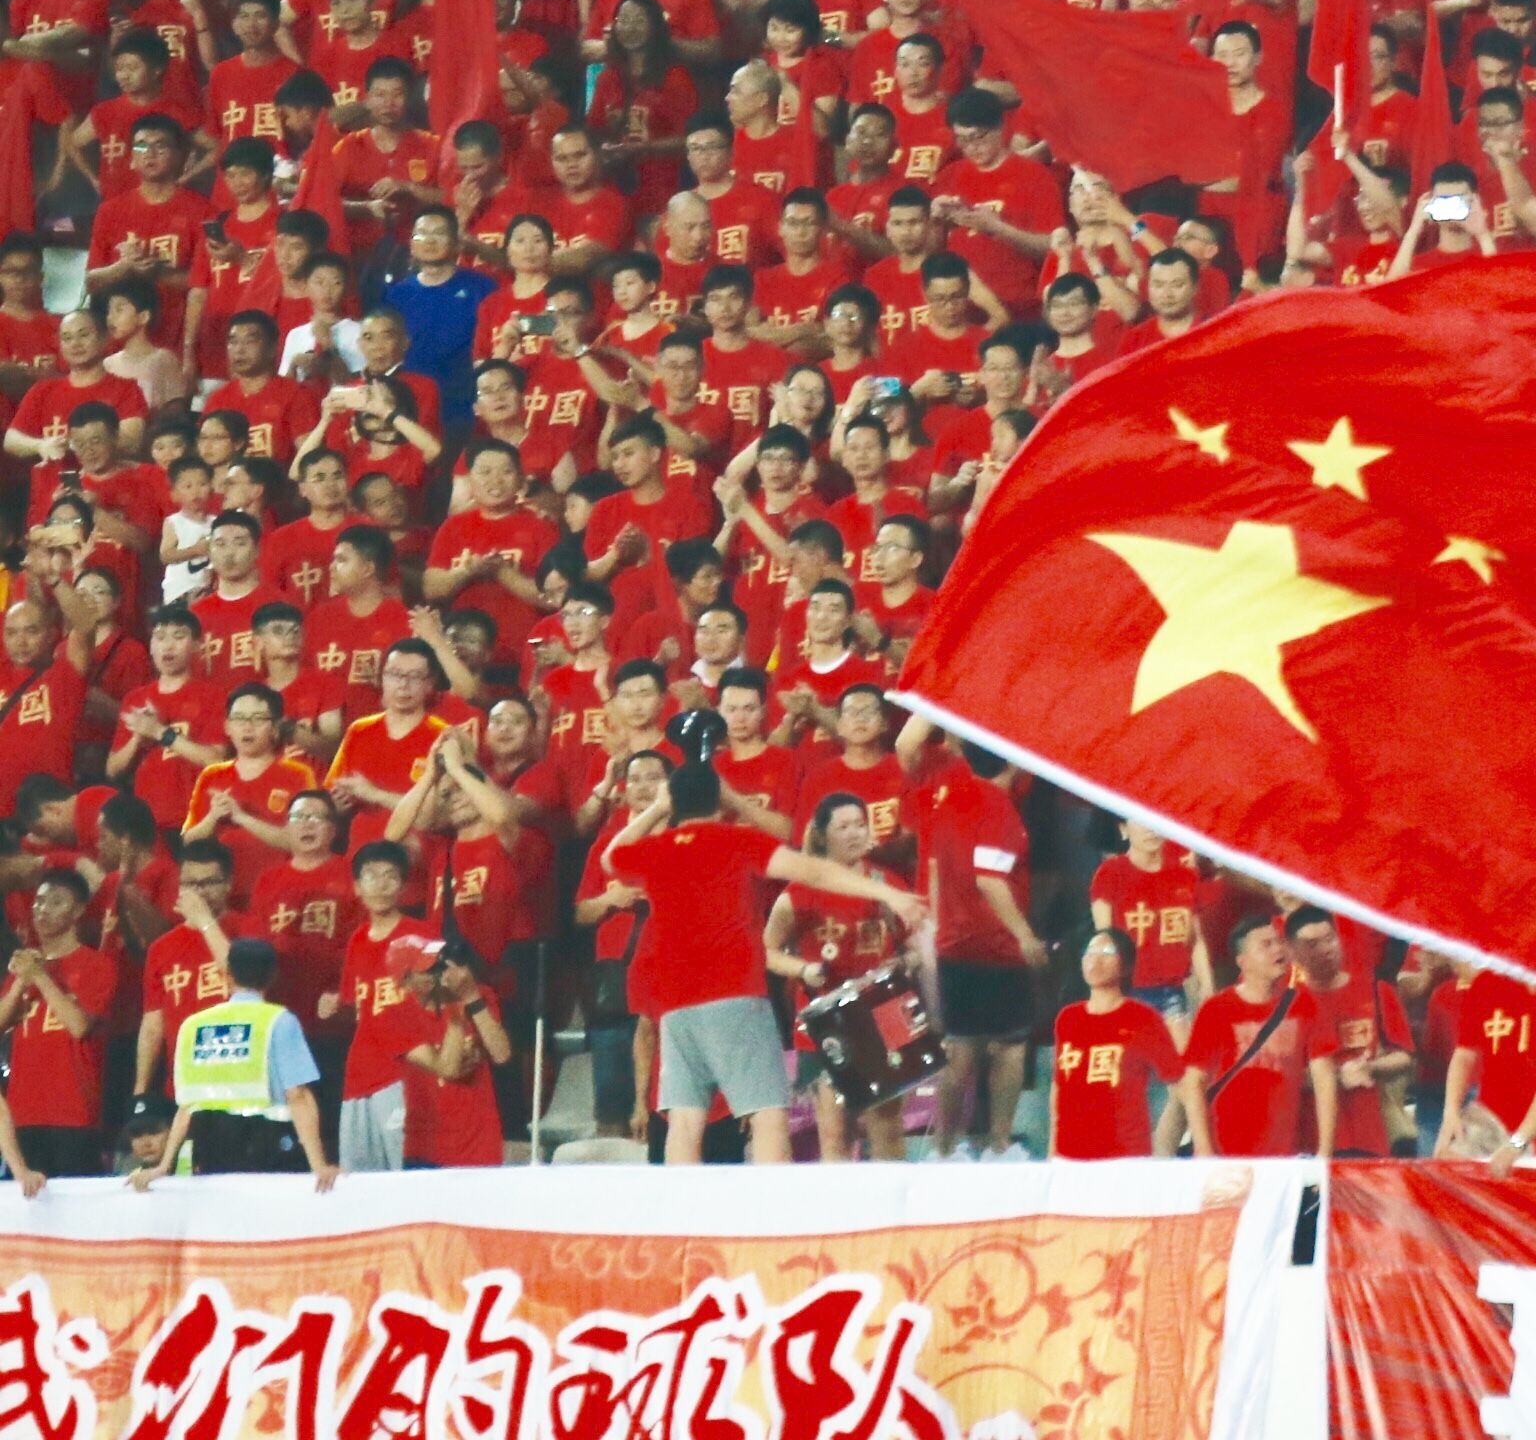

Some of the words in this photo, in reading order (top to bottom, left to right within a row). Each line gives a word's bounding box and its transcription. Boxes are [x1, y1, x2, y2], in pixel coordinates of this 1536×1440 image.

[224, 100, 282, 140] 中国
[524, 388, 588, 426] 中国
[695, 382, 760, 425] 中国
[199, 632, 261, 673] 中国
[319, 642, 380, 684] 中国
[553, 709, 609, 746] 中国
[271, 902, 336, 938] 中国
[1126, 902, 1189, 943] 中国
[164, 958, 229, 1006] 中国
[1057, 1043, 1122, 1087] 中国
